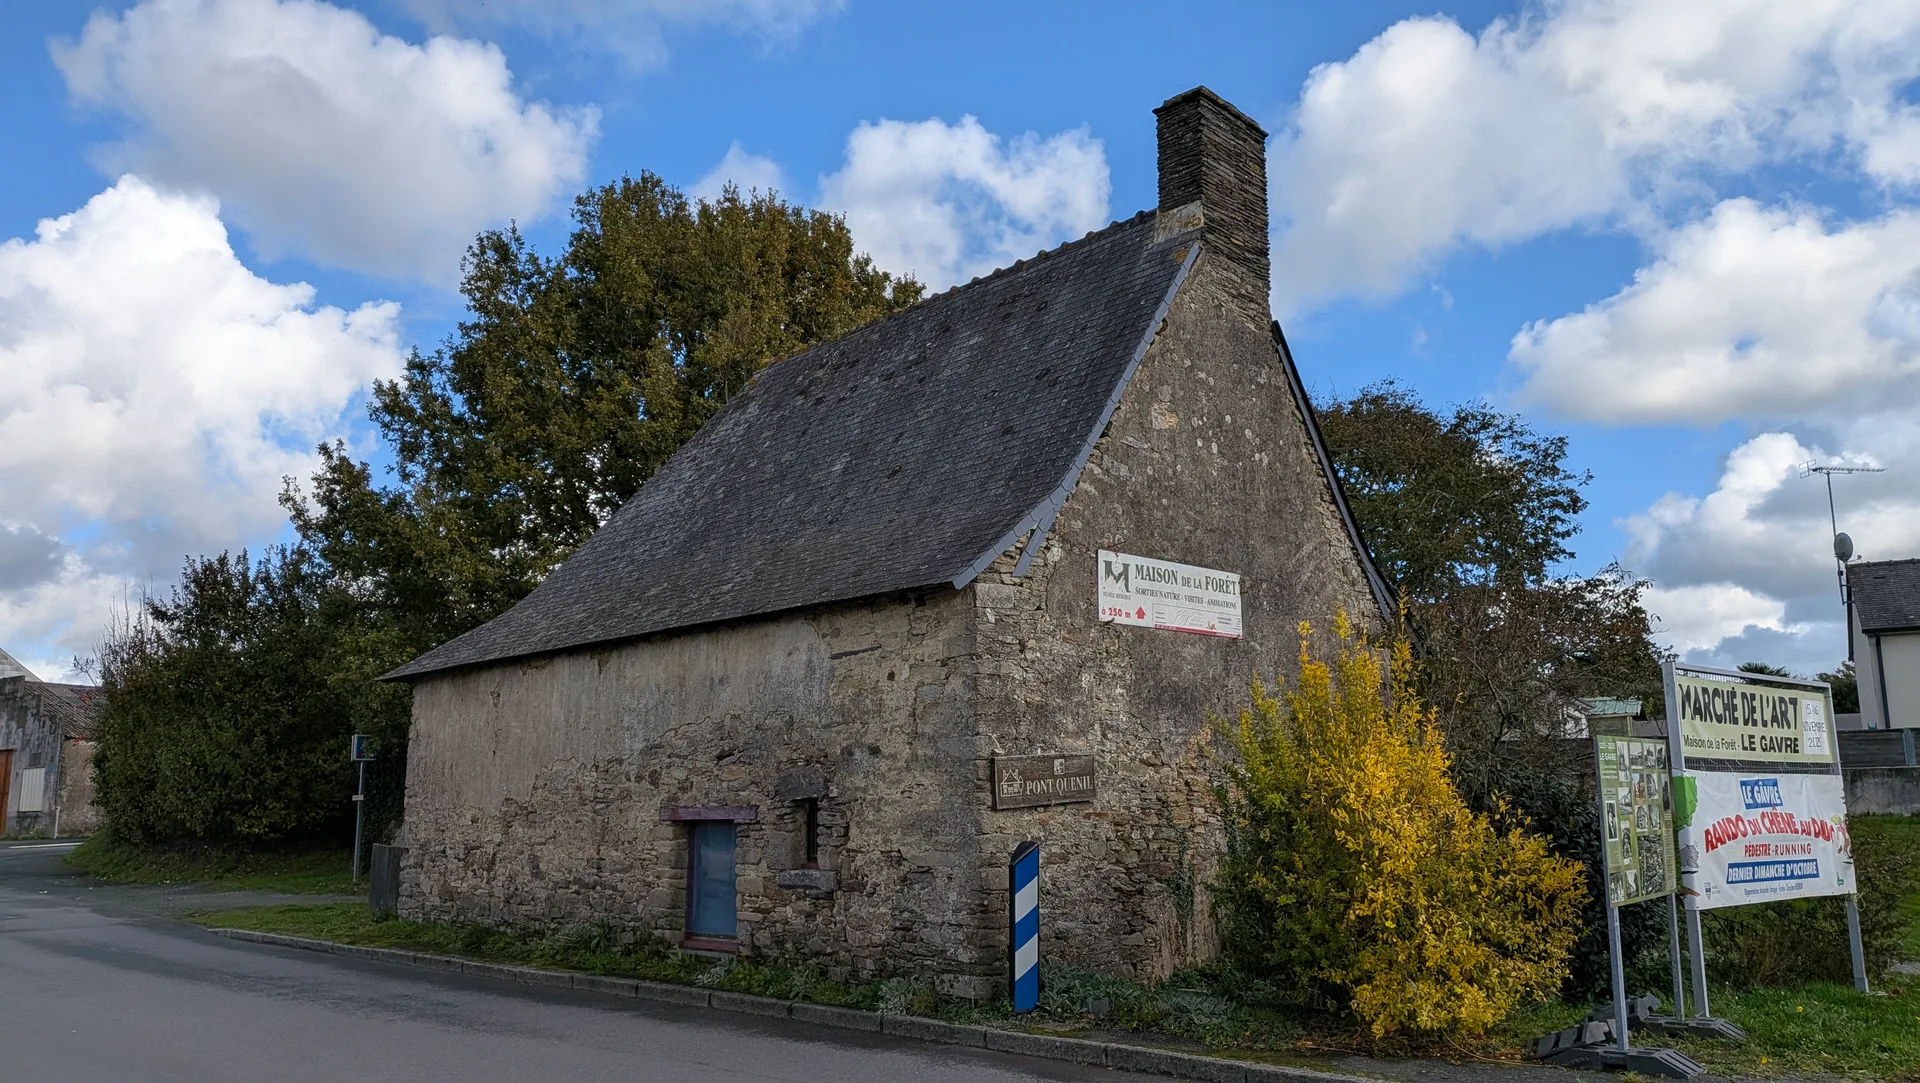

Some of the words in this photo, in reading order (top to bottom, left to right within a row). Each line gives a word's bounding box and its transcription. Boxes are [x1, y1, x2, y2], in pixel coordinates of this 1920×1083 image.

[1135, 563, 1178, 586] MAISON
[1181, 576, 1191, 588] DE
[1193, 577, 1202, 590] LA
[1204, 575, 1237, 596] FORÊT
[1135, 586, 1159, 598] SORTIES
[1159, 590, 1181, 601] NATURE
[1184, 594, 1204, 604] VISITES
[1206, 598, 1237, 610] ANIMATIONS
[1108, 606, 1123, 617] 250
[1124, 611, 1131, 619] m
[1678, 683, 1739, 726] MARCHÉ
[1741, 691, 1758, 728] DE
[1760, 693, 1798, 730] L'ART
[1683, 734, 1706, 748] Maison
[1706, 736, 1714, 748] de
[1715, 737, 1720, 749] la
[1721, 738, 1737, 750] Forêt
[1741, 734, 1756, 751] LE
[1759, 735, 1800, 754] GAVRE
[1025, 778, 1054, 795] PONT
[1056, 776, 1093, 796] QUENIL
[1741, 785, 1753, 804] LE
[1753, 781, 1782, 804] GÂVRE
[1704, 814, 1748, 854] RANDO
[1746, 818, 1762, 836] DU
[1760, 806, 1800, 835] CHÊNE
[1799, 820, 1812, 837] AU
[1744, 841, 1771, 857] PÉDESTRE
[1774, 843, 1812, 856] RUNNING
[1728, 865, 1753, 882] DERNIER
[1754, 863, 1785, 879] DIMANCHE
[1786, 861, 1818, 876] D'OCTOBRE
